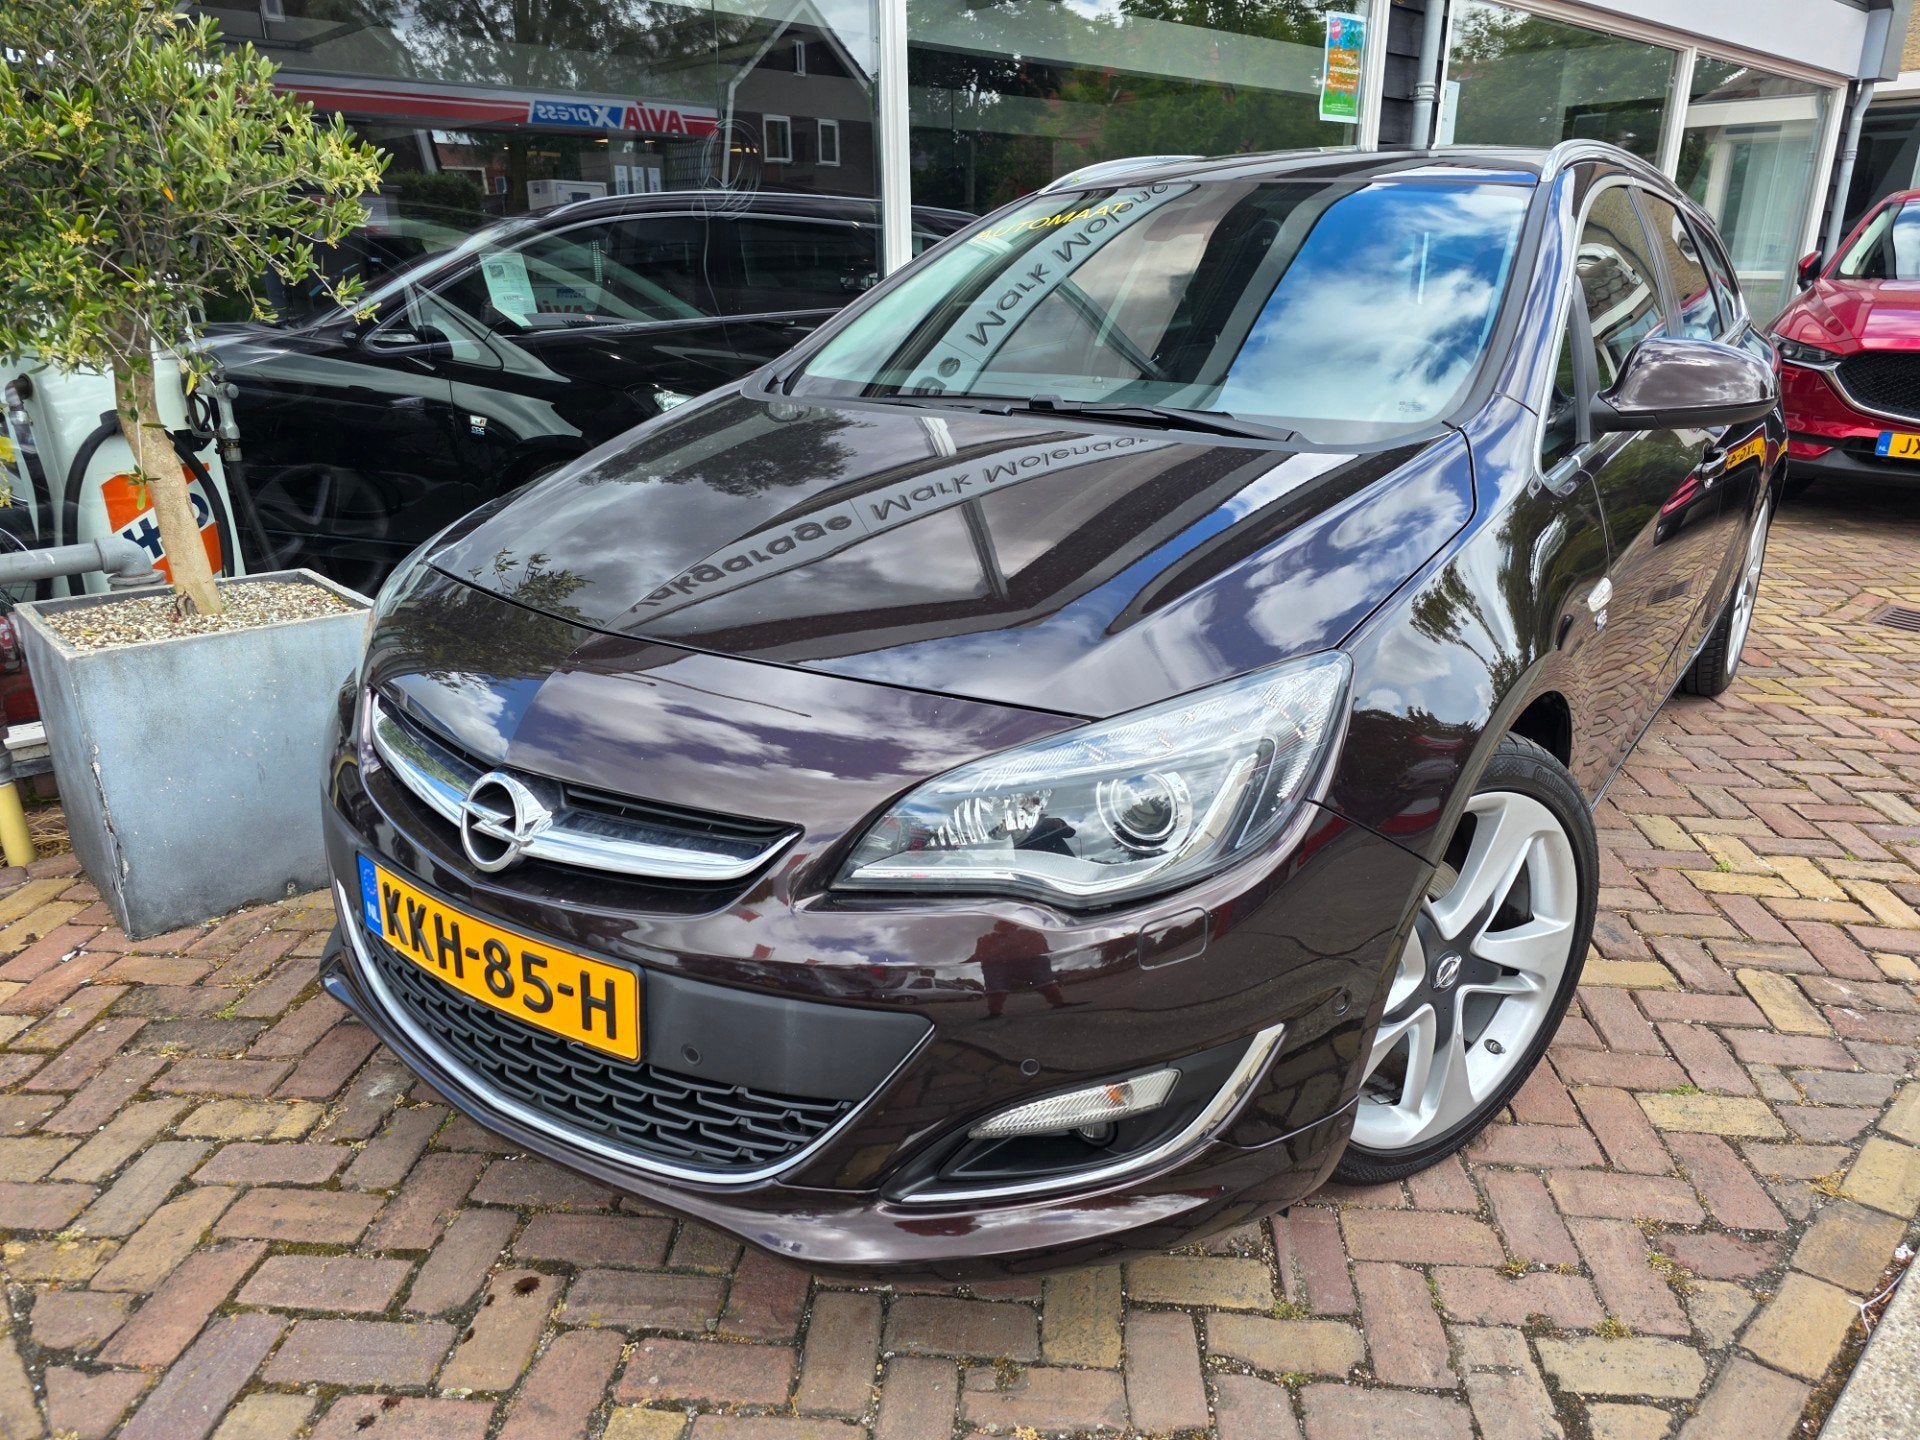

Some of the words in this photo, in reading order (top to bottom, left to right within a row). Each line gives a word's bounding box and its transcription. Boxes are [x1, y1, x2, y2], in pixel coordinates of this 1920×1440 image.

[971, 200, 1125, 244] AUTOMAAT
[367, 900, 381, 923] NL
[382, 880, 618, 1041] KKH-85-H
